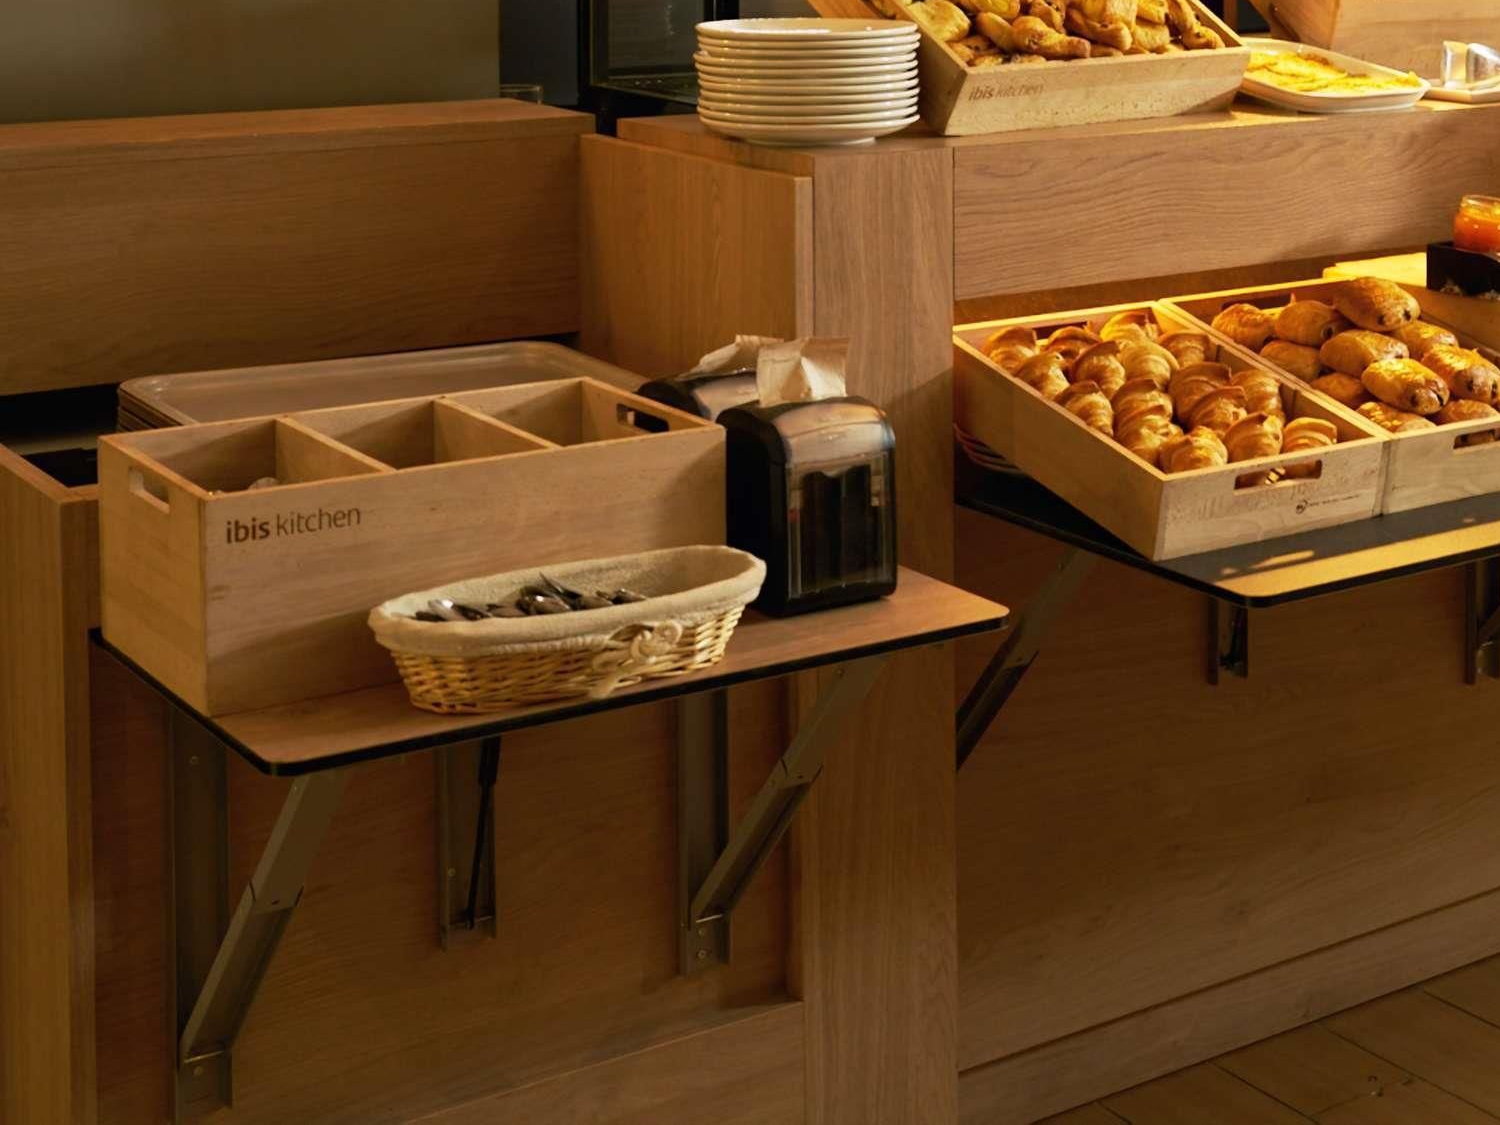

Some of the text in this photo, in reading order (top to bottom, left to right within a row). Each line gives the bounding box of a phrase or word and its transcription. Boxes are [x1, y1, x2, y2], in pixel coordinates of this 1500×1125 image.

[968, 83, 994, 101] ibis
[226, 507, 361, 544] ibis kitchen
